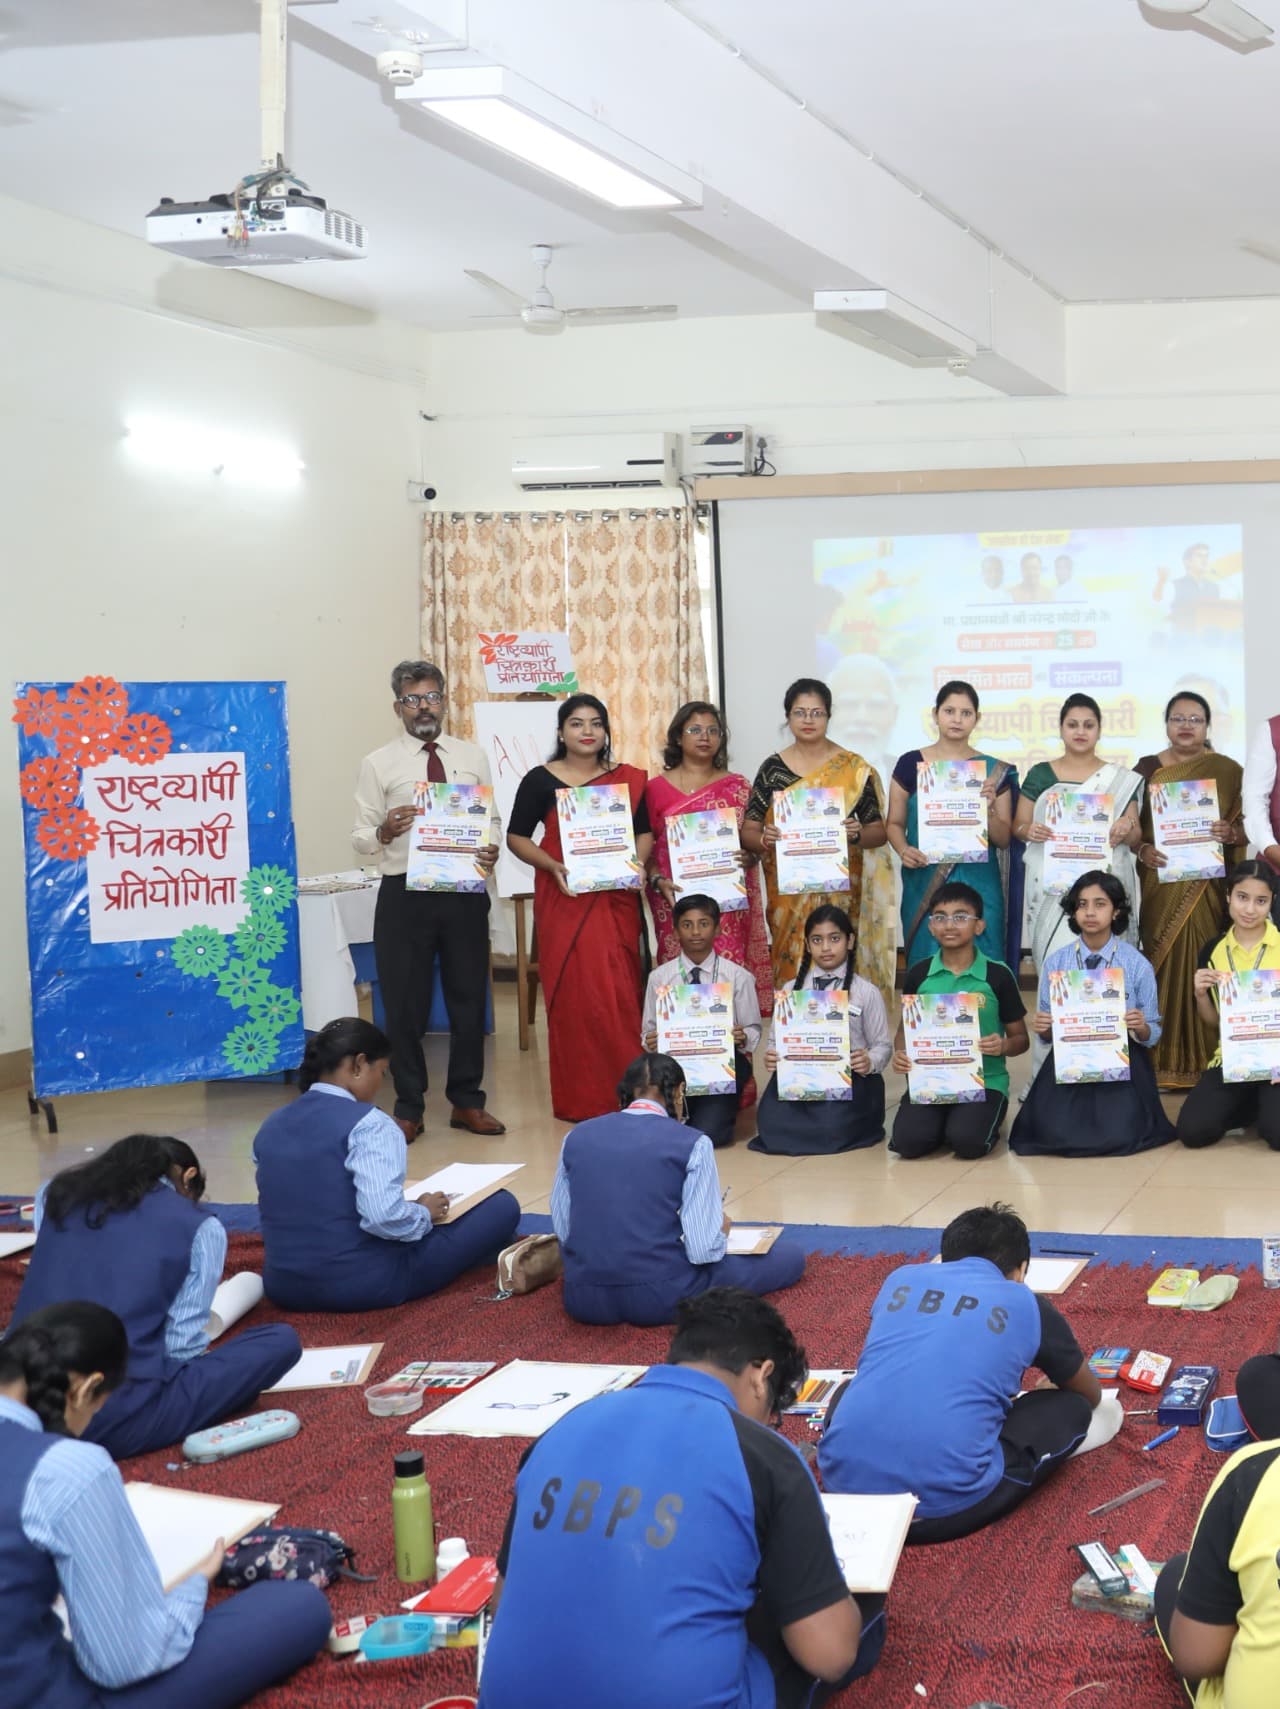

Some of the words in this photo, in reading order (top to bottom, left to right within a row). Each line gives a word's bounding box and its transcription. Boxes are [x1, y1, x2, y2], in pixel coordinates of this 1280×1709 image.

[94, 760, 241, 812] राष्ट्रव्यापी
[101, 812, 235, 860] चित्रकारी
[101, 866, 237, 911] प्रतियोगिता
[886, 1285, 1010, 1335] SBPS
[532, 1476, 686, 1549] SBPS
